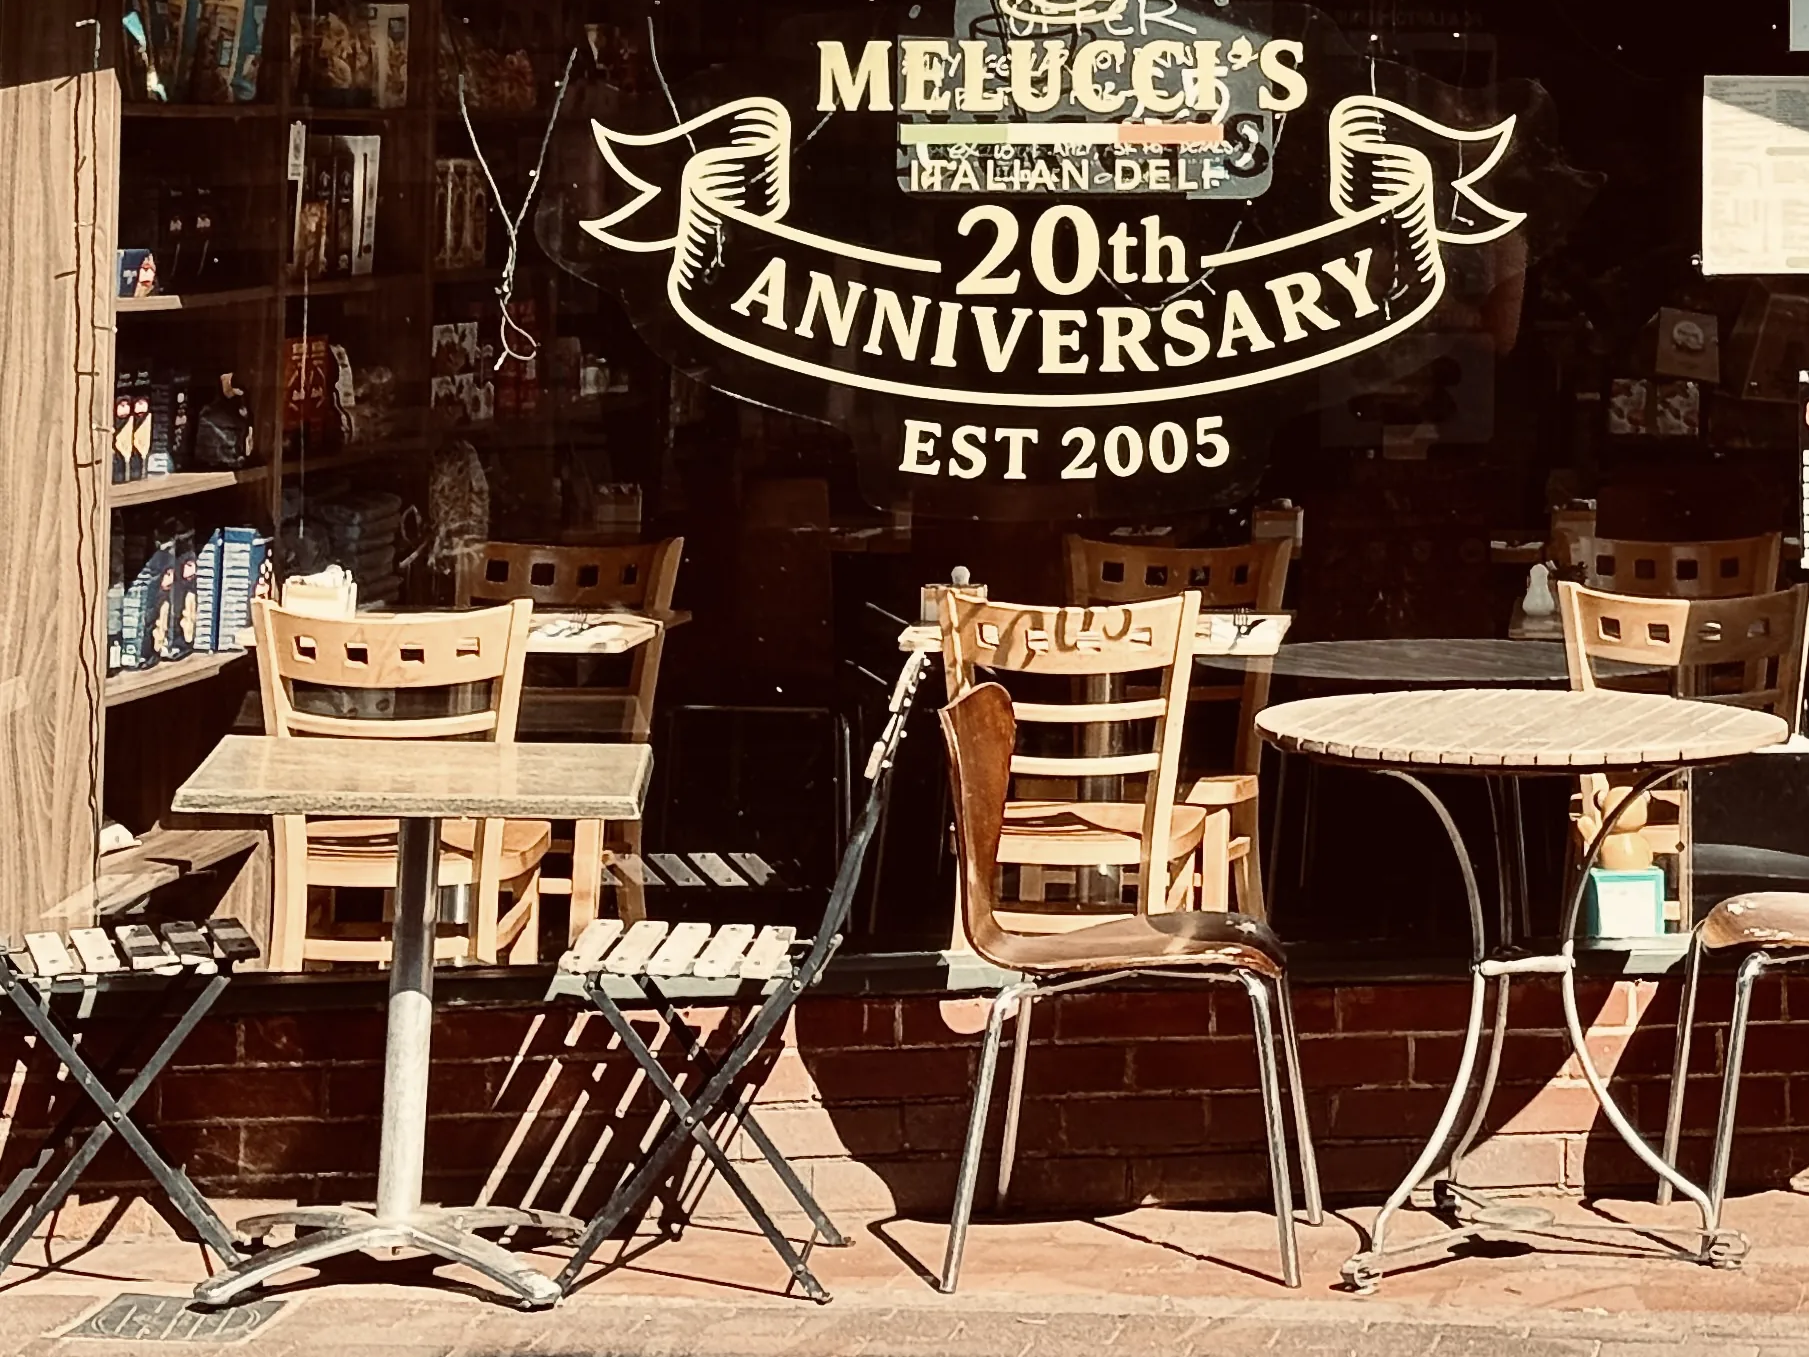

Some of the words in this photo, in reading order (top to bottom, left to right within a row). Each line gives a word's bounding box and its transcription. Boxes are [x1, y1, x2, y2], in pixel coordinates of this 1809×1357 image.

[816, 38, 1308, 113] MELUCCI'S
[909, 159, 1090, 192] ITALIAN
[955, 204, 1190, 296] 20th
[730, 247, 1382, 375] ANNIVERSARY
[898, 418, 1039, 480] EST
[1060, 414, 1231, 481] 2005
